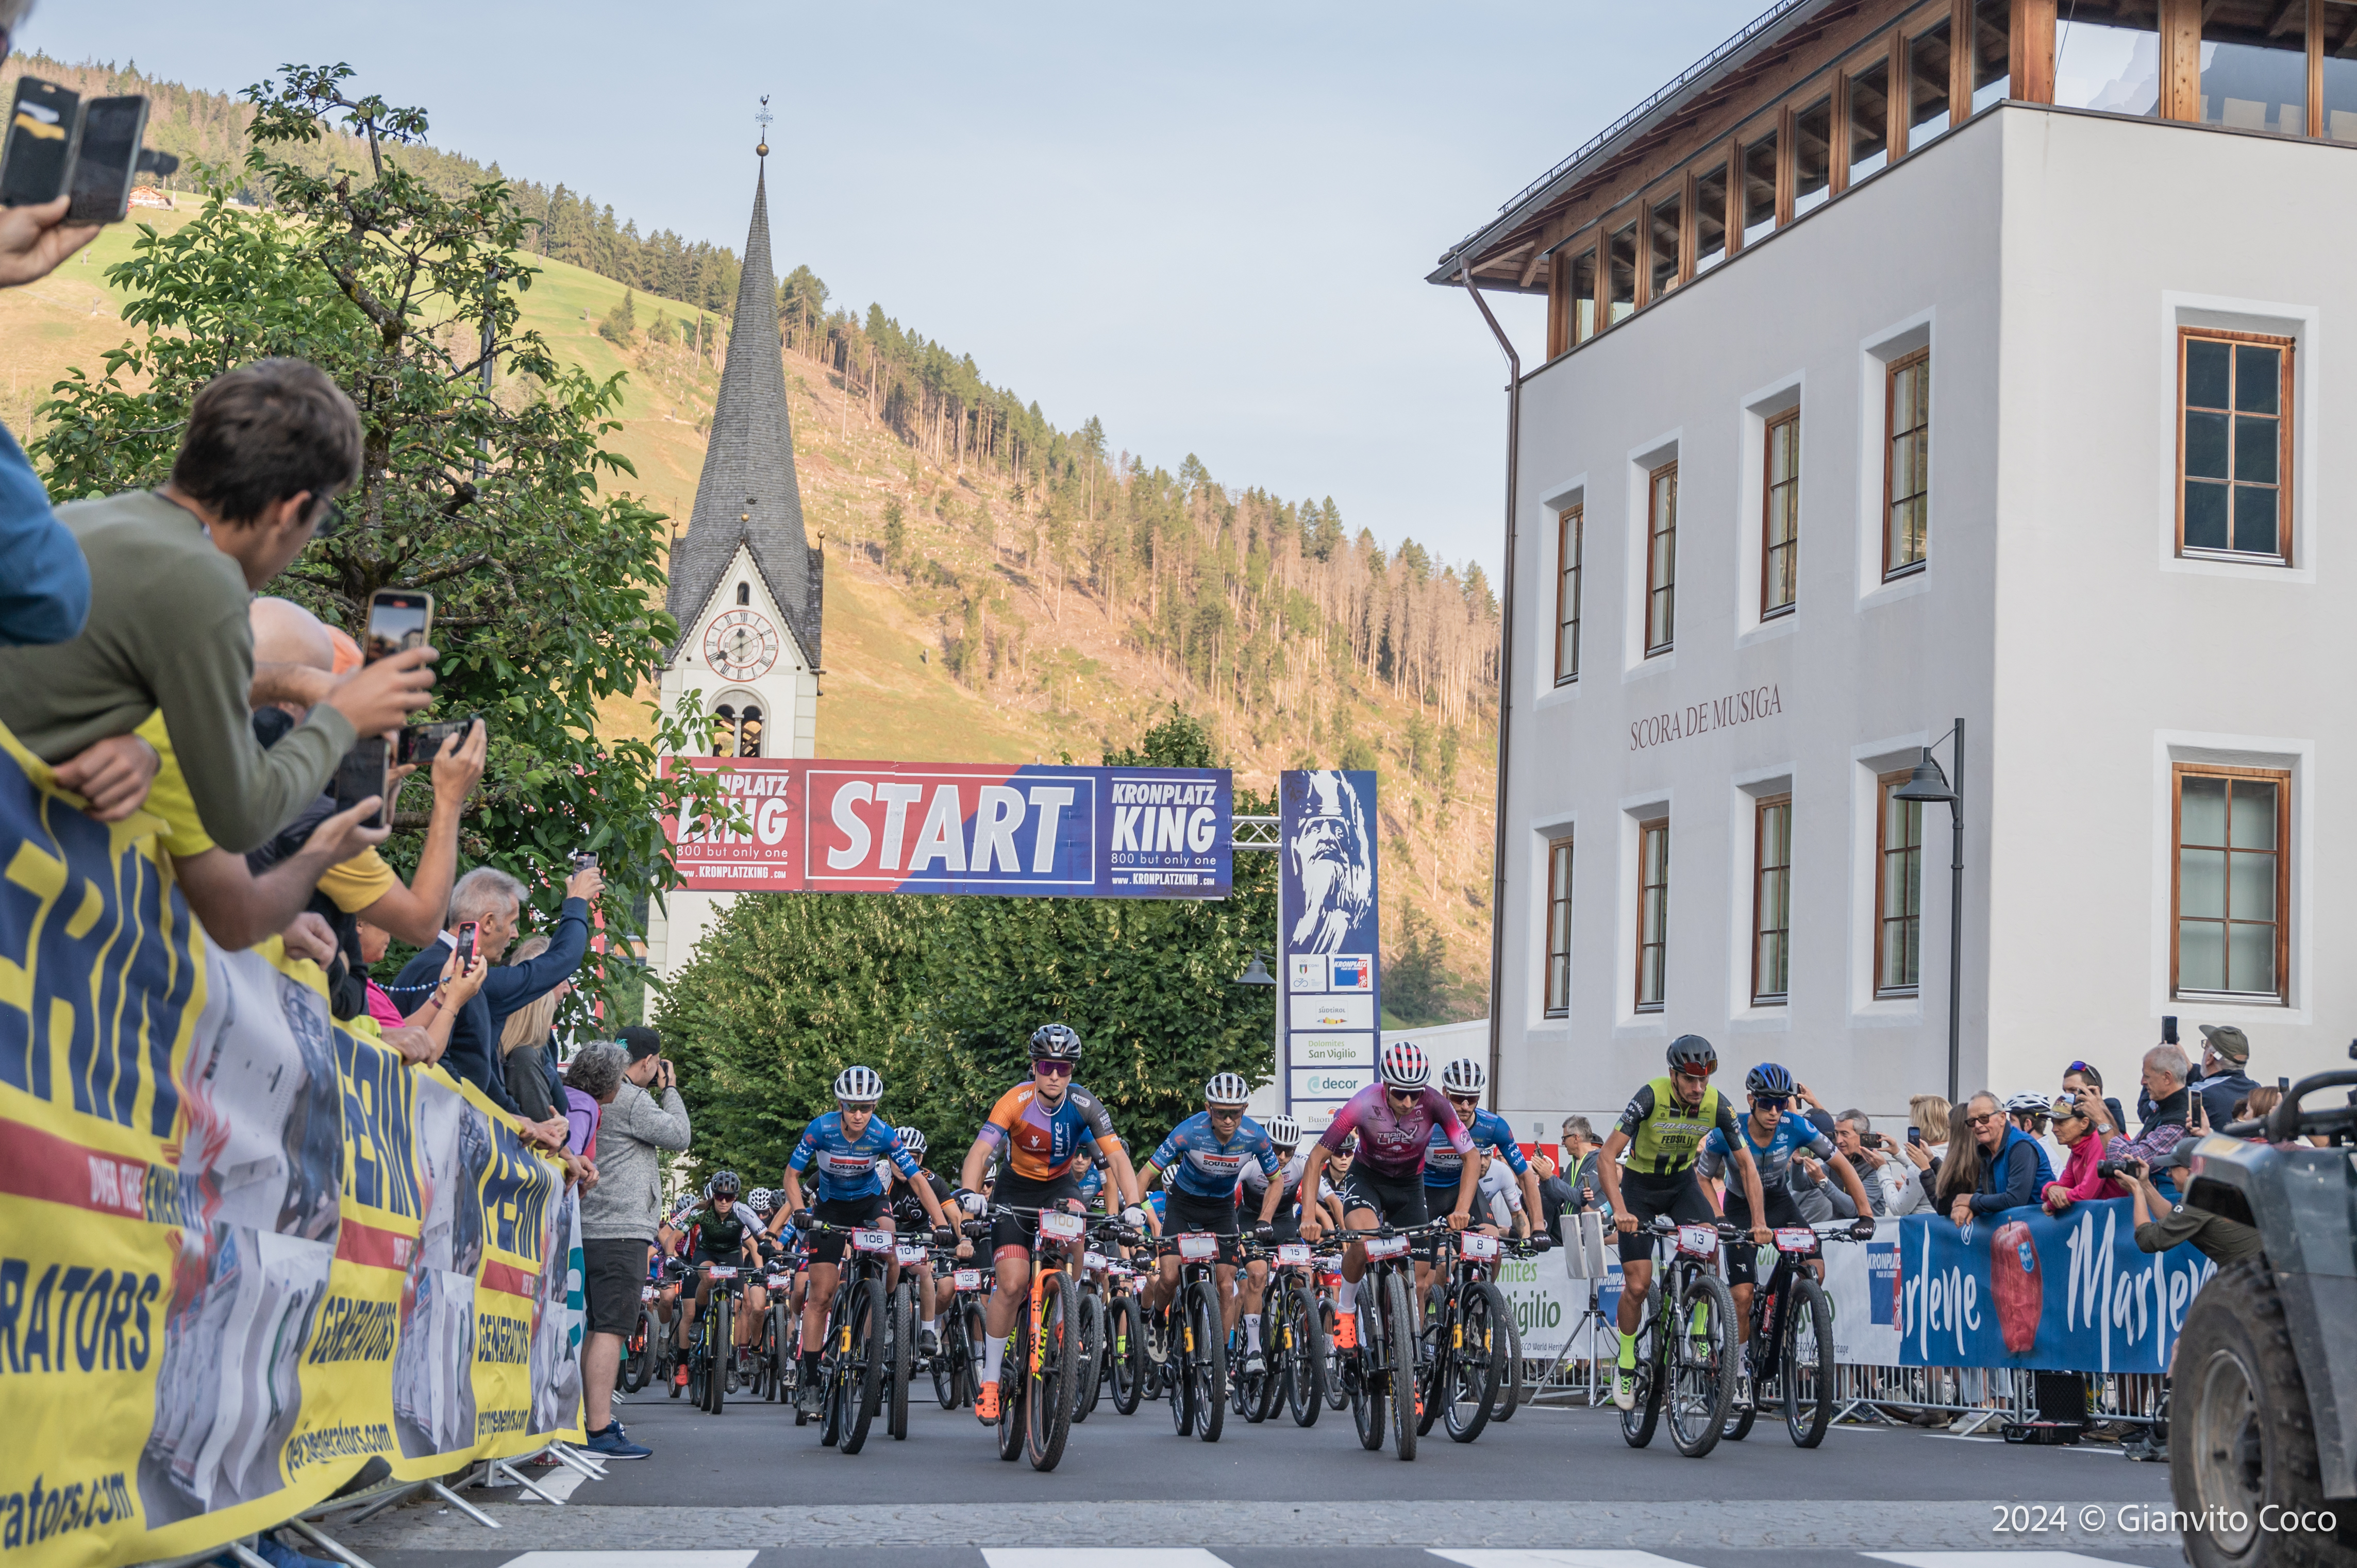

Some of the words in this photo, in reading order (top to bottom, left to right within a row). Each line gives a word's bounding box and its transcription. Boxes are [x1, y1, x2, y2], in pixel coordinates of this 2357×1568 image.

[1630, 711, 1682, 751] SCORA
[1685, 702, 1709, 737] DE
[1712, 683, 1782, 730] MUSIGA
[677, 771, 789, 796] NPLATZ
[1112, 784, 1217, 805] KRONPLATZ
[827, 781, 1074, 872] START
[1111, 806, 1216, 853] KING
[676, 846, 701, 856] 800
[707, 846, 726, 856] but
[733, 846, 759, 859] only
[1111, 853, 1134, 864] 800
[1141, 853, 1159, 864] but
[1165, 854, 1189, 867] only
[1308, 1050, 1325, 1058] San
[1327, 1048, 1356, 1060] Vigilio
[1323, 1077, 1358, 1089] decor
[1676, 1123, 1711, 1133] BIKE
[1054, 1122, 1064, 1157] pure
[1203, 1160, 1239, 1168] SOUDAL
[1052, 1215, 1074, 1227] 100
[863, 1234, 883, 1243] 106
[1477, 1240, 1483, 1250] 8
[1693, 1232, 1704, 1245] 13
[899, 1247, 916, 1255] 101
[1195, 1241, 1200, 1250] 1
[1868, 1253, 1901, 1270] KRONPLATZ
[1497, 1260, 1537, 1283] mites
[1533, 1342, 1546, 1351] World
